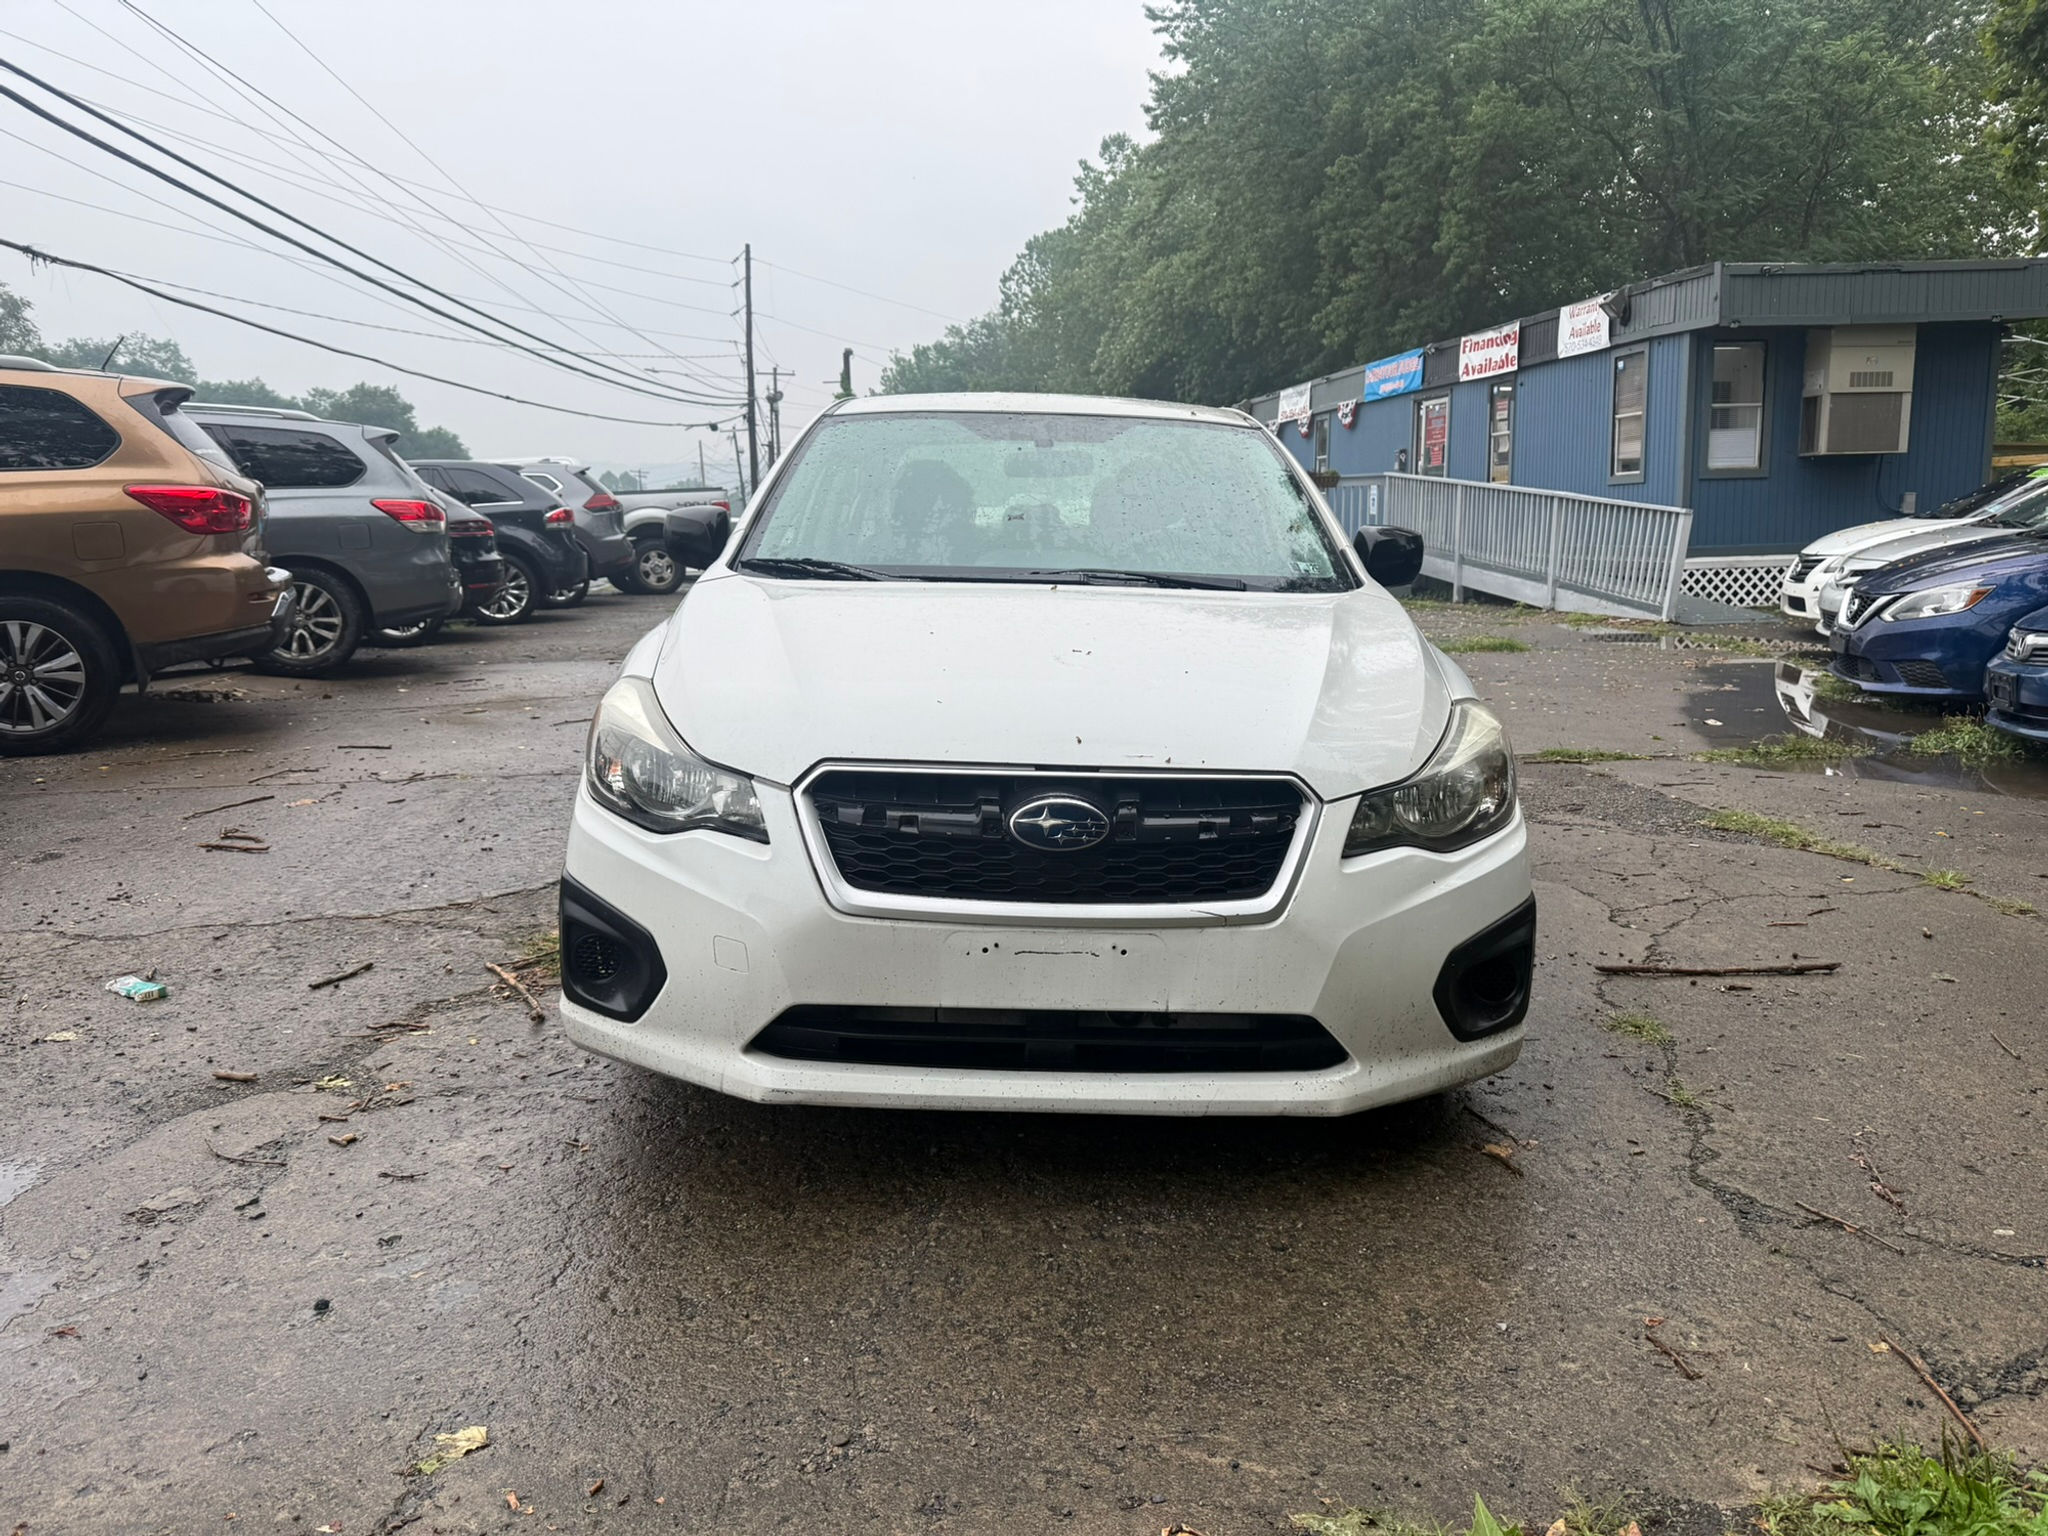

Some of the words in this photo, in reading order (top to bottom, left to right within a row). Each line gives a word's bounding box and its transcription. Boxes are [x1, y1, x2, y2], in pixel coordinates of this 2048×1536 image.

[1462, 329, 1518, 354] Financing
[1568, 320, 1602, 340] Available
[1461, 353, 1517, 377] Available
